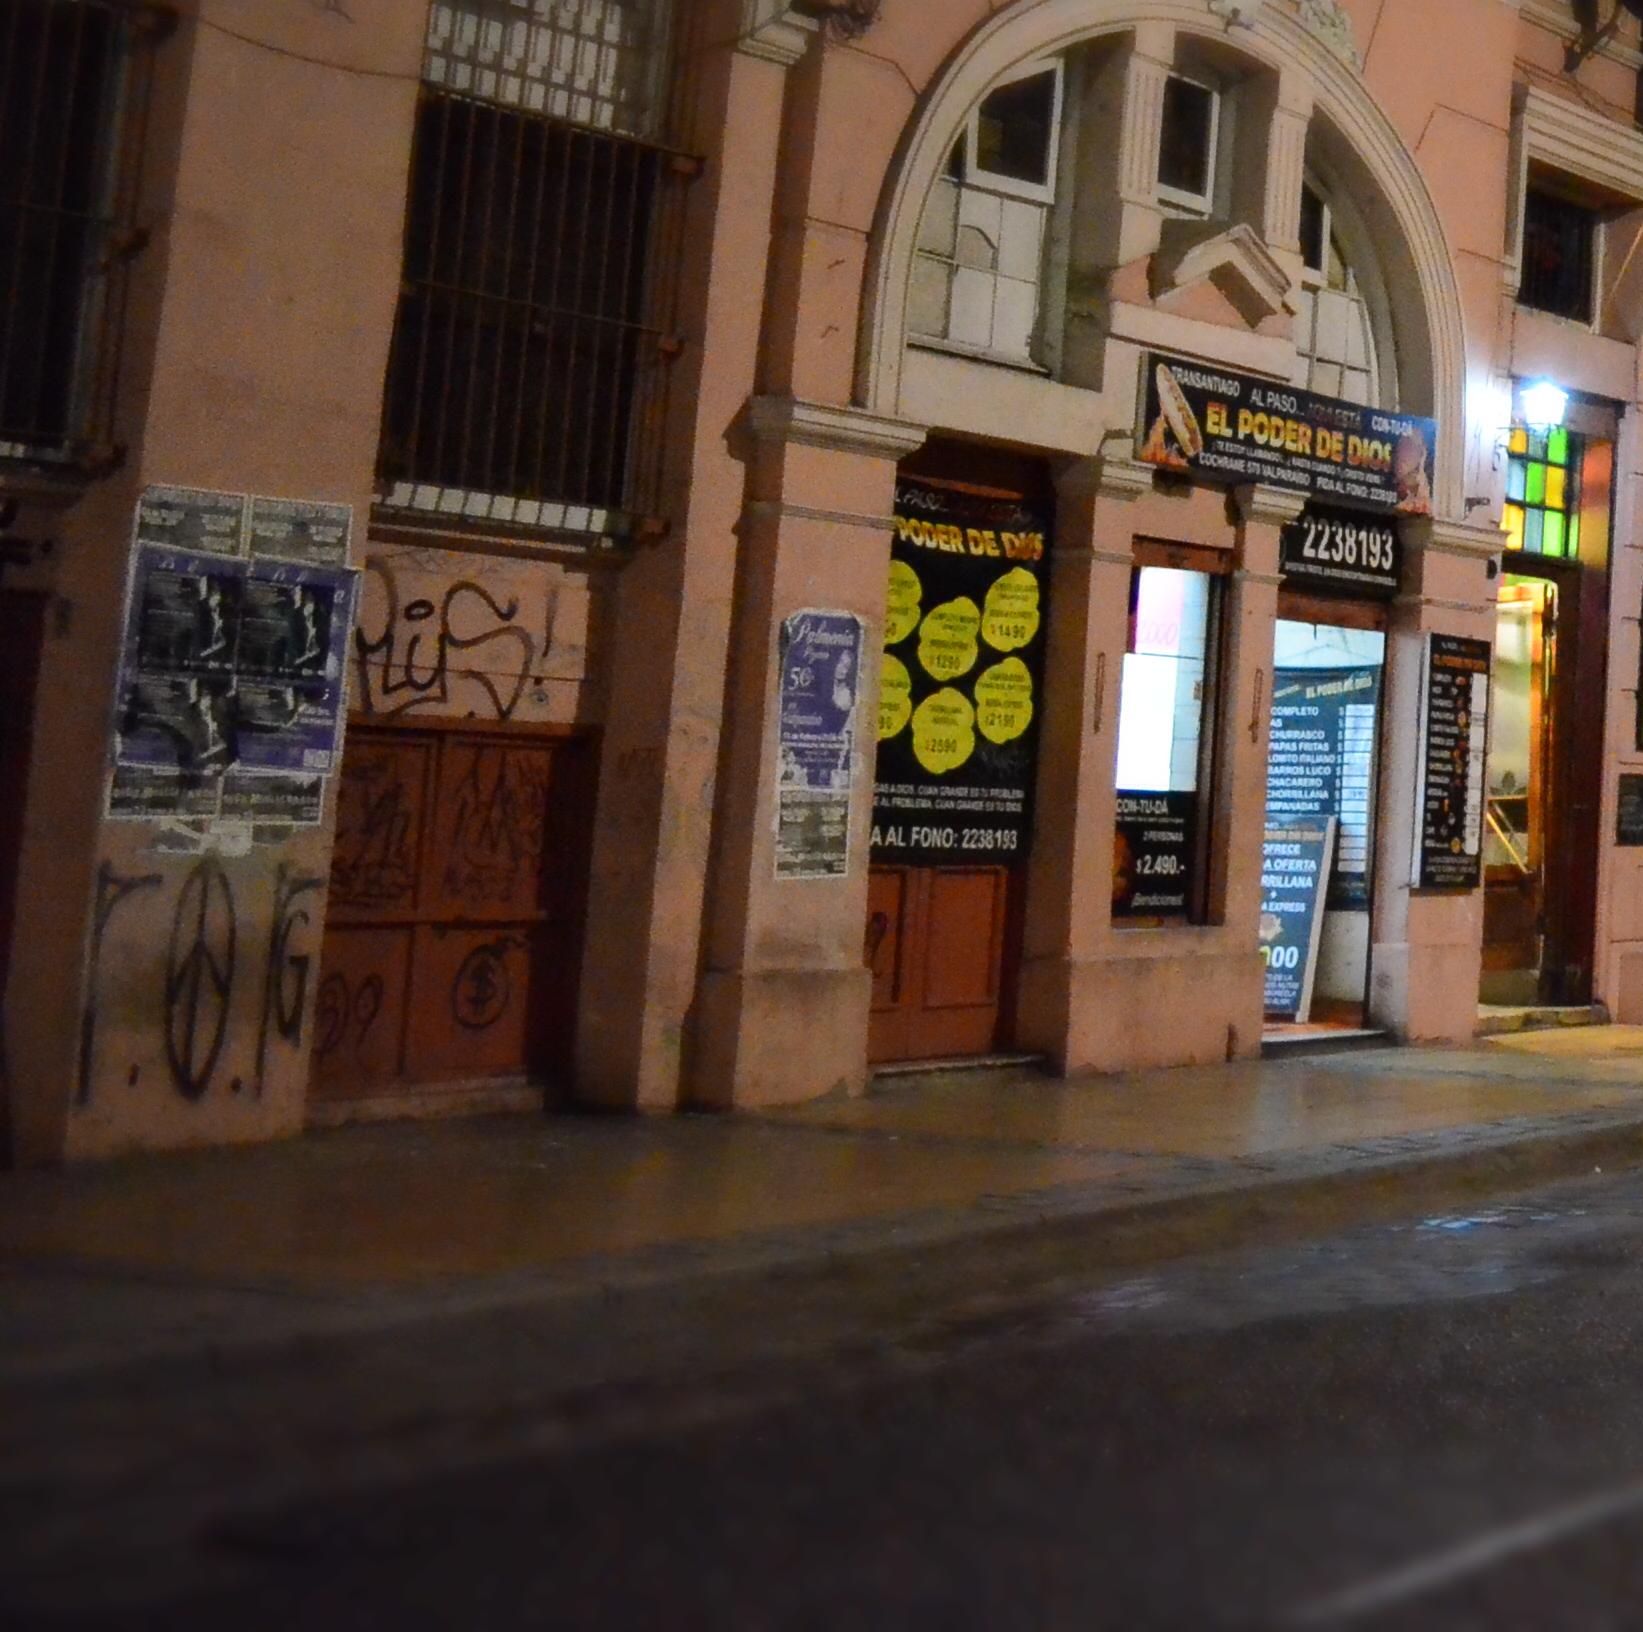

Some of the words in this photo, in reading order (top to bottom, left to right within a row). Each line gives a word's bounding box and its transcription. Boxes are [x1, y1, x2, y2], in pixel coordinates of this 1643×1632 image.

[1171, 366, 1241, 398] TRANSANTIAGO
[1250, 388, 1264, 407] AL
[1206, 401, 1233, 438] EL
[1237, 407, 1312, 455] PODER
[1315, 426, 1343, 463] DE
[1199, 452, 1246, 473] COCHRANE
[895, 514, 966, 555] PODER
[966, 527, 1001, 557] DE
[1303, 514, 1393, 571] 2238193
[1270, 706, 1319, 717] COMPLETO
[1269, 729, 1325, 740] CHURRASCO
[1268, 741, 1297, 752] PAPAS
[1298, 741, 1329, 752] FRITAS
[1306, 766, 1332, 776] LUCO
[885, 825, 906, 848] AL
[909, 826, 959, 848] FONO:
[961, 827, 1018, 851] 2238193
[1274, 859, 1318, 873] OFERTA
